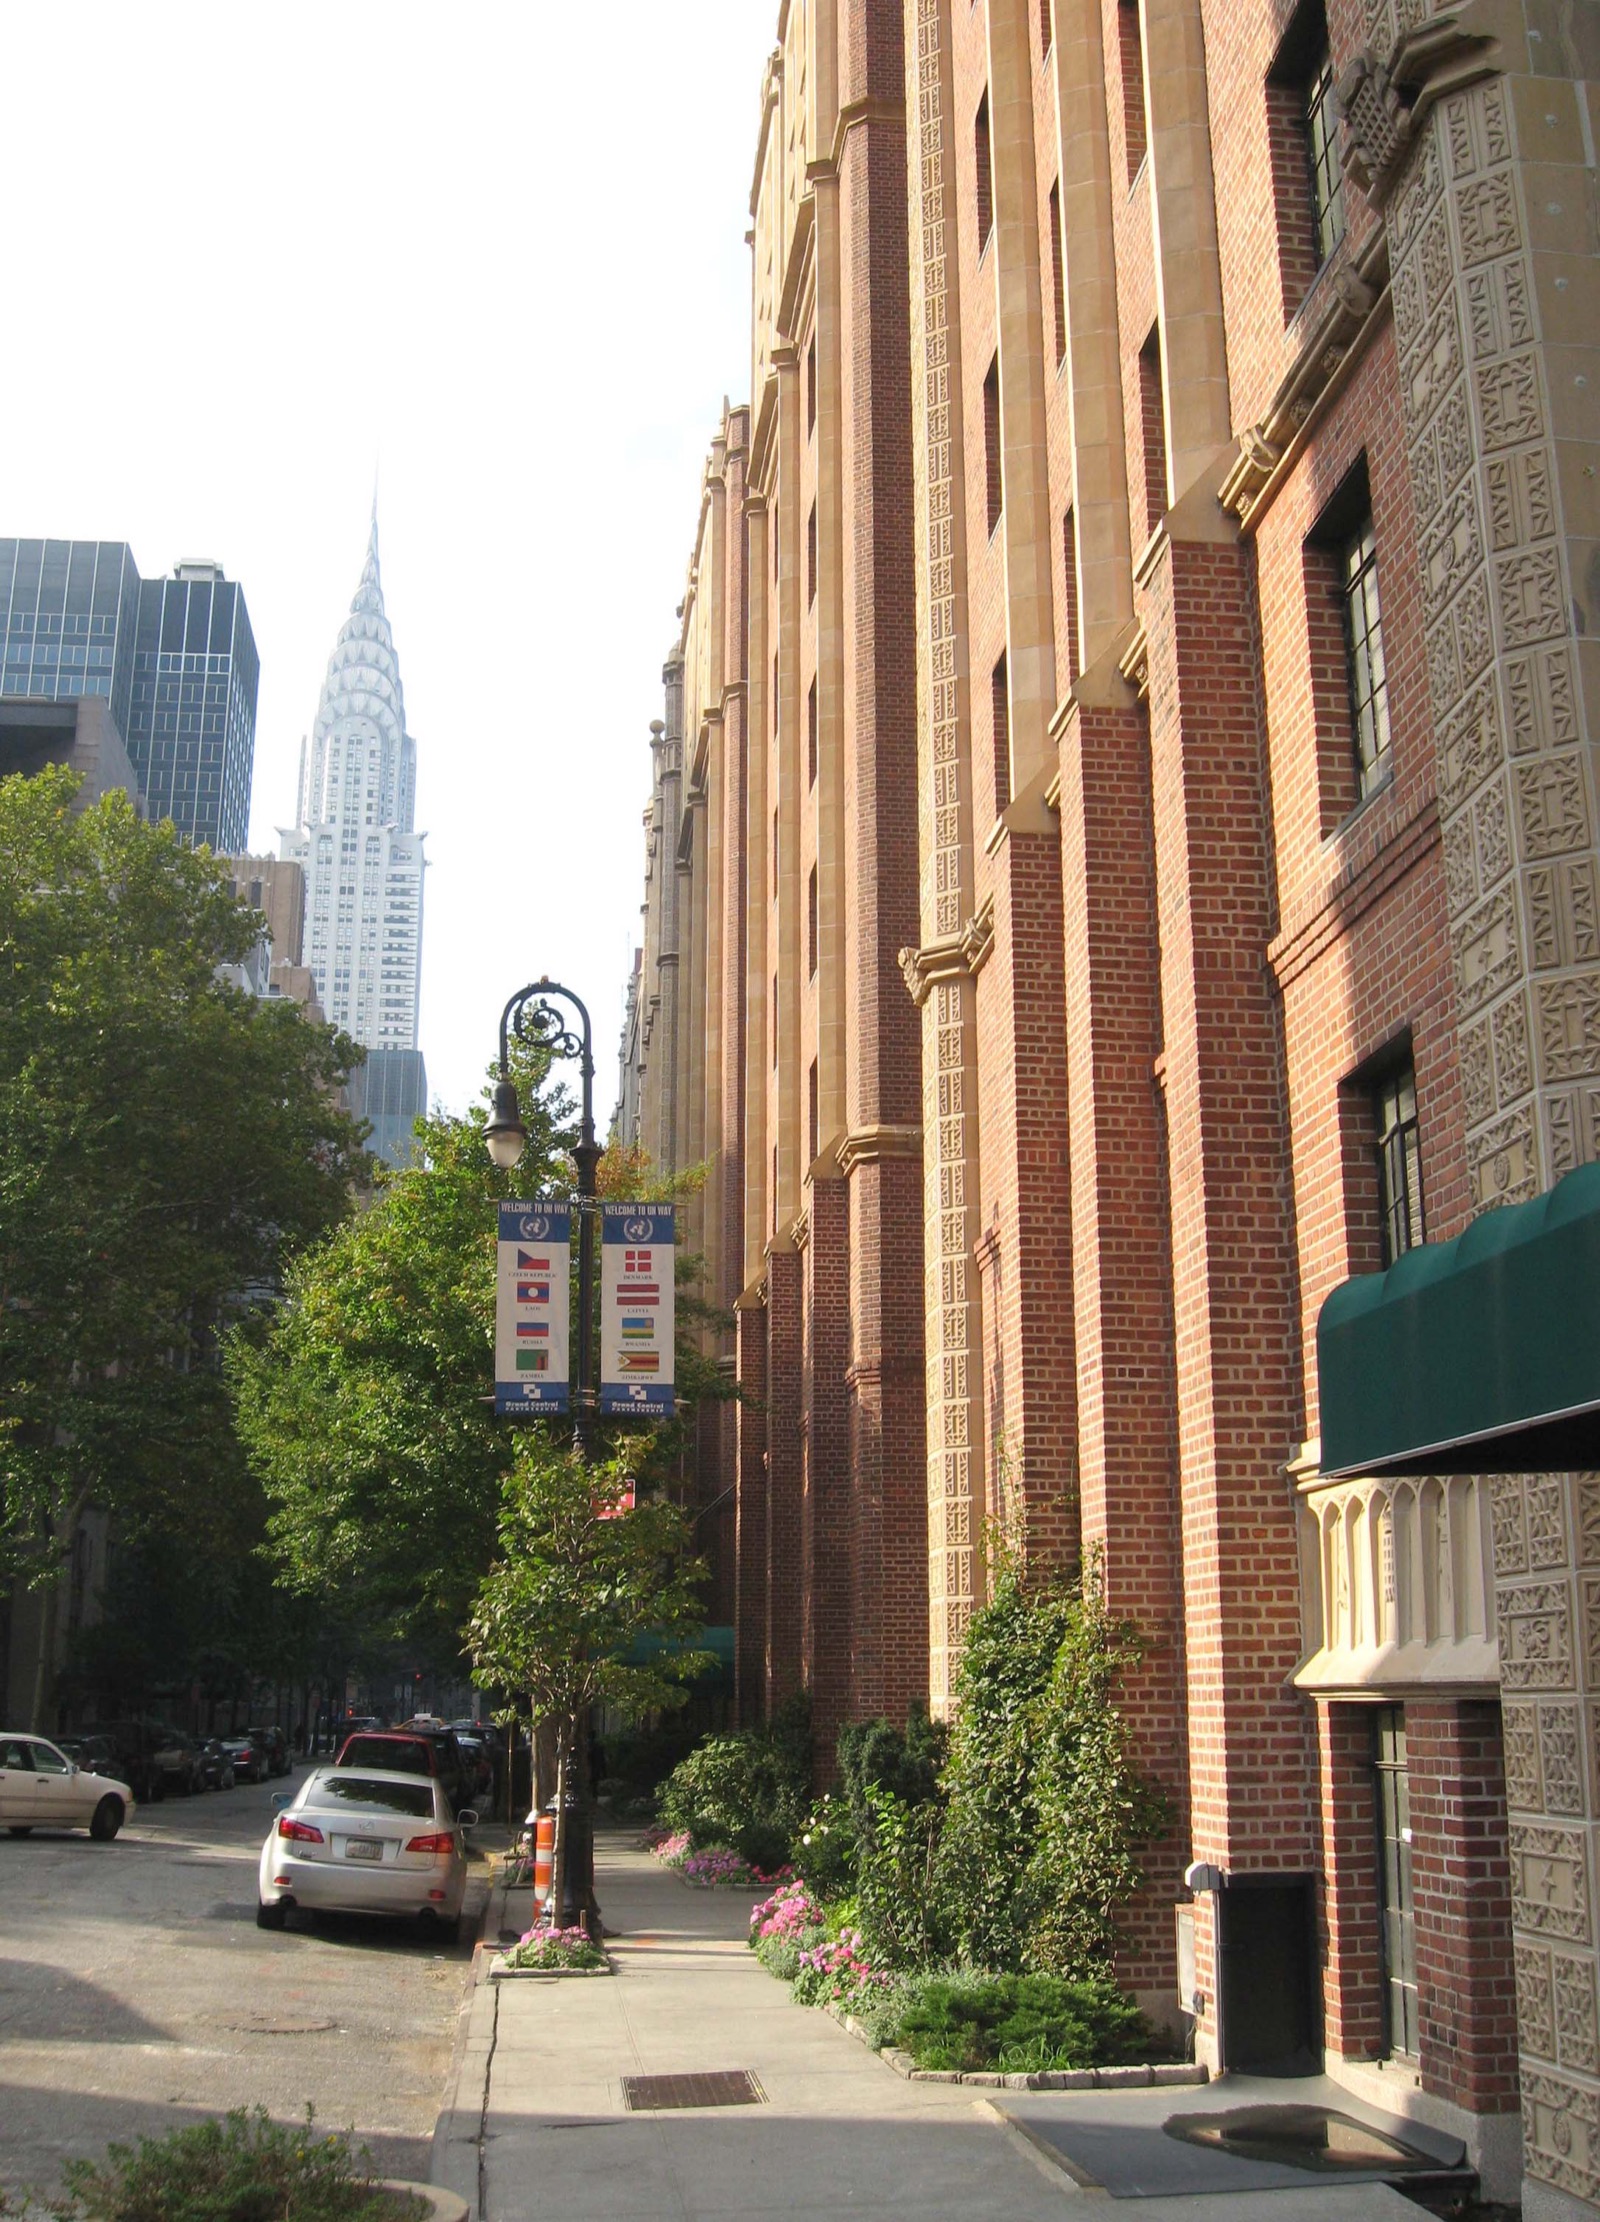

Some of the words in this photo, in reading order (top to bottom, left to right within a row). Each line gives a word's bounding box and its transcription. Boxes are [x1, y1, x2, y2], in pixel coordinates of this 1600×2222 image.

[501, 1202, 532, 1213] WELCOME
[534, 1203, 543, 1213] TO
[554, 1203, 569, 1214] WAY
[605, 1205, 636, 1215] WELCOME
[638, 1205, 646, 1215] TO
[657, 1206, 672, 1216] WAY
